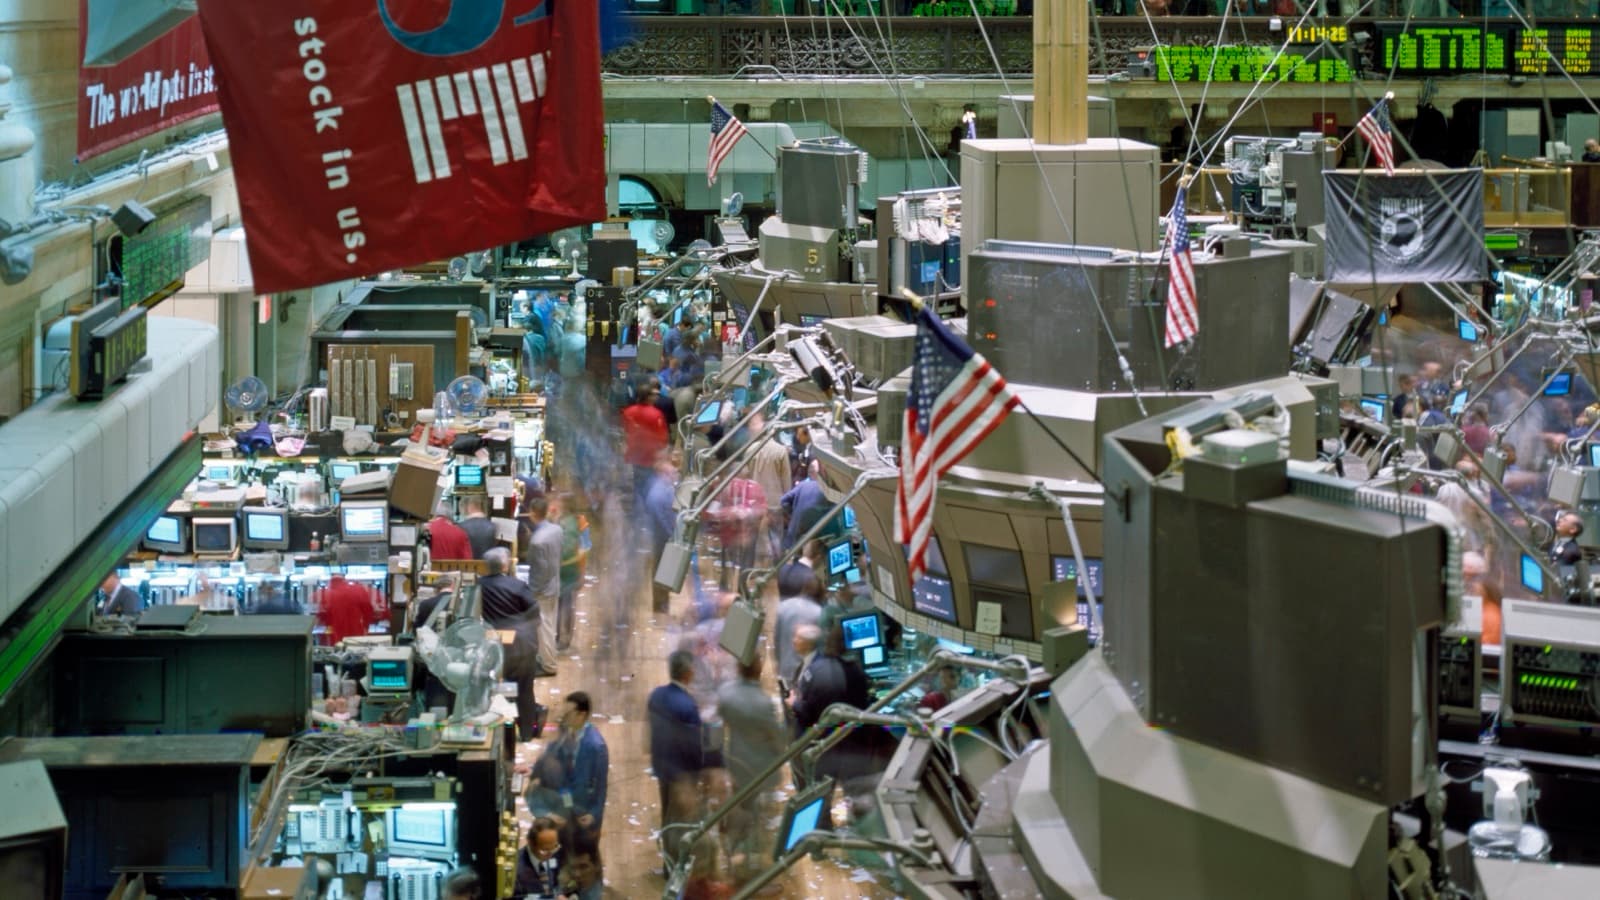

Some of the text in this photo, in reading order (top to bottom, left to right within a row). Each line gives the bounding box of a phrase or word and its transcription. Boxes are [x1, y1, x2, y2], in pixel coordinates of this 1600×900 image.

[86, 83, 115, 129] The
[203, 65, 218, 94] st
[294, 16, 368, 264] stock in us.
[808, 248, 819, 264] 5
